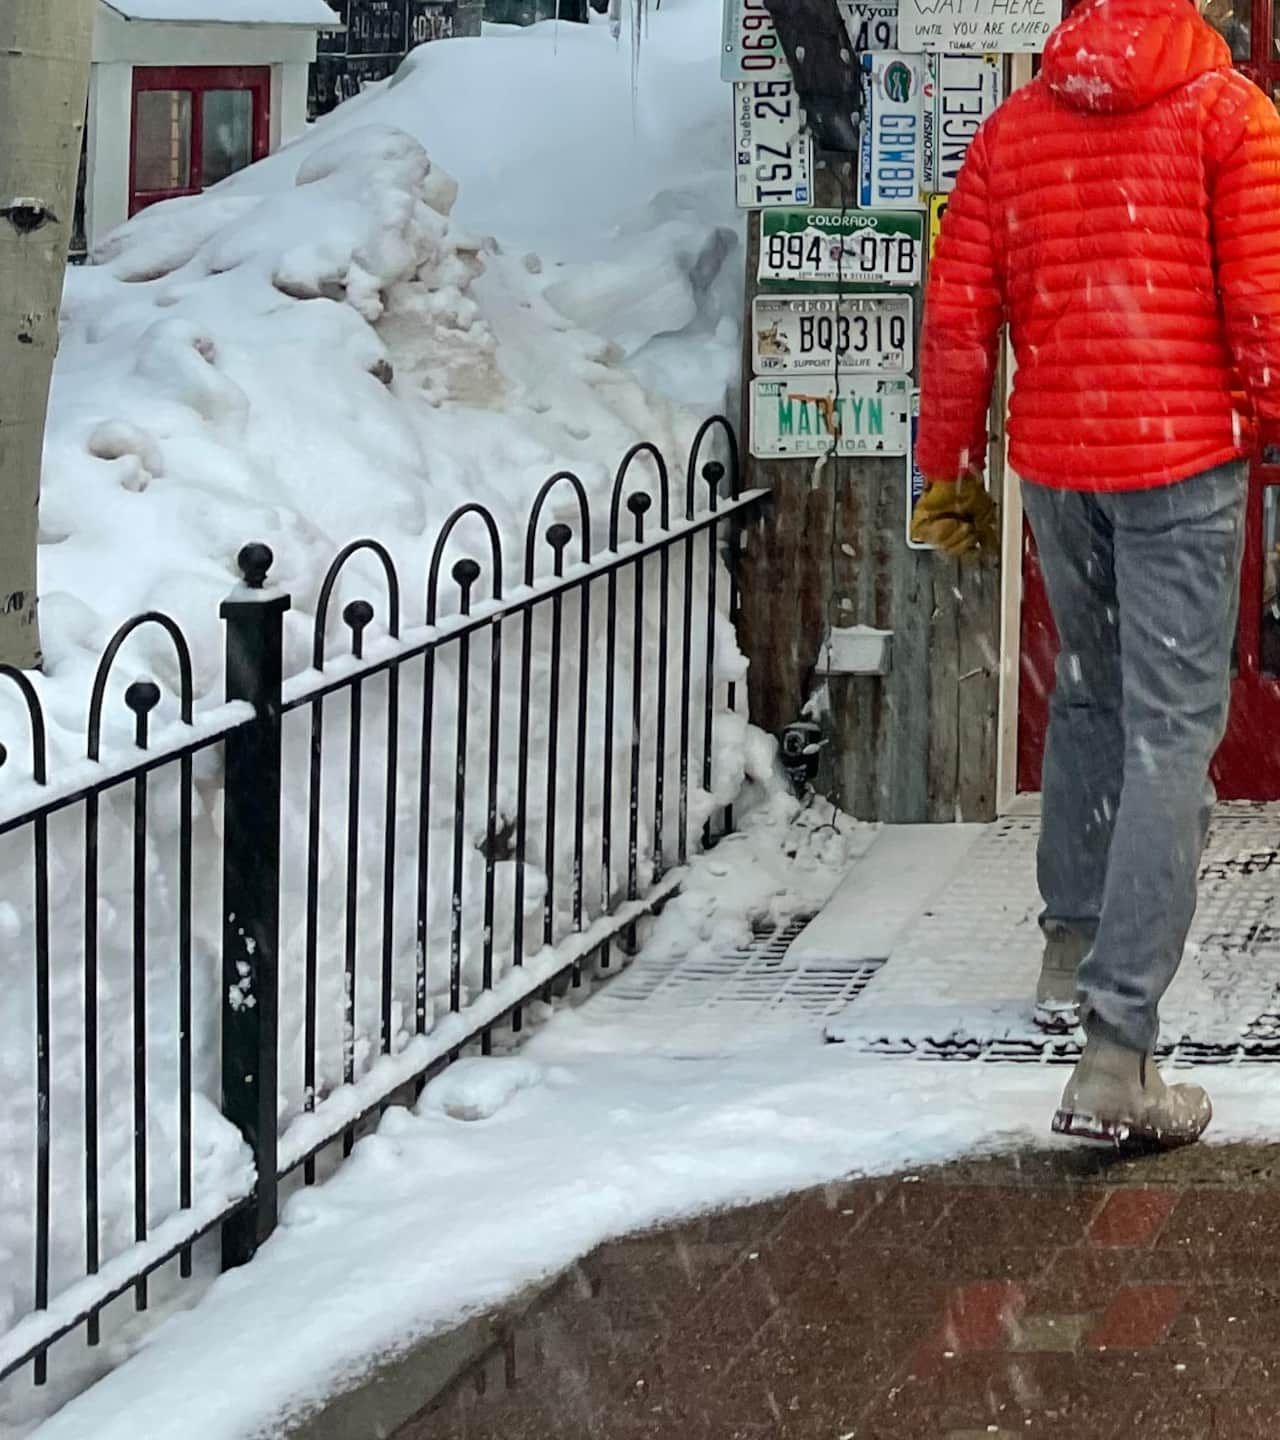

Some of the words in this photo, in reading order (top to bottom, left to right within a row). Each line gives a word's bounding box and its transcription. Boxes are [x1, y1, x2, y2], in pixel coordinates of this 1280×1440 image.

[914, 23, 944, 36] UNTIL
[953, 21, 977, 36] YOU
[983, 22, 1005, 36] ARE
[741, 96, 752, 149] Québec
[923, 110, 933, 183] WISCONSIN
[806, 215, 879, 229] COLORADO
[768, 235, 823, 272] 894
